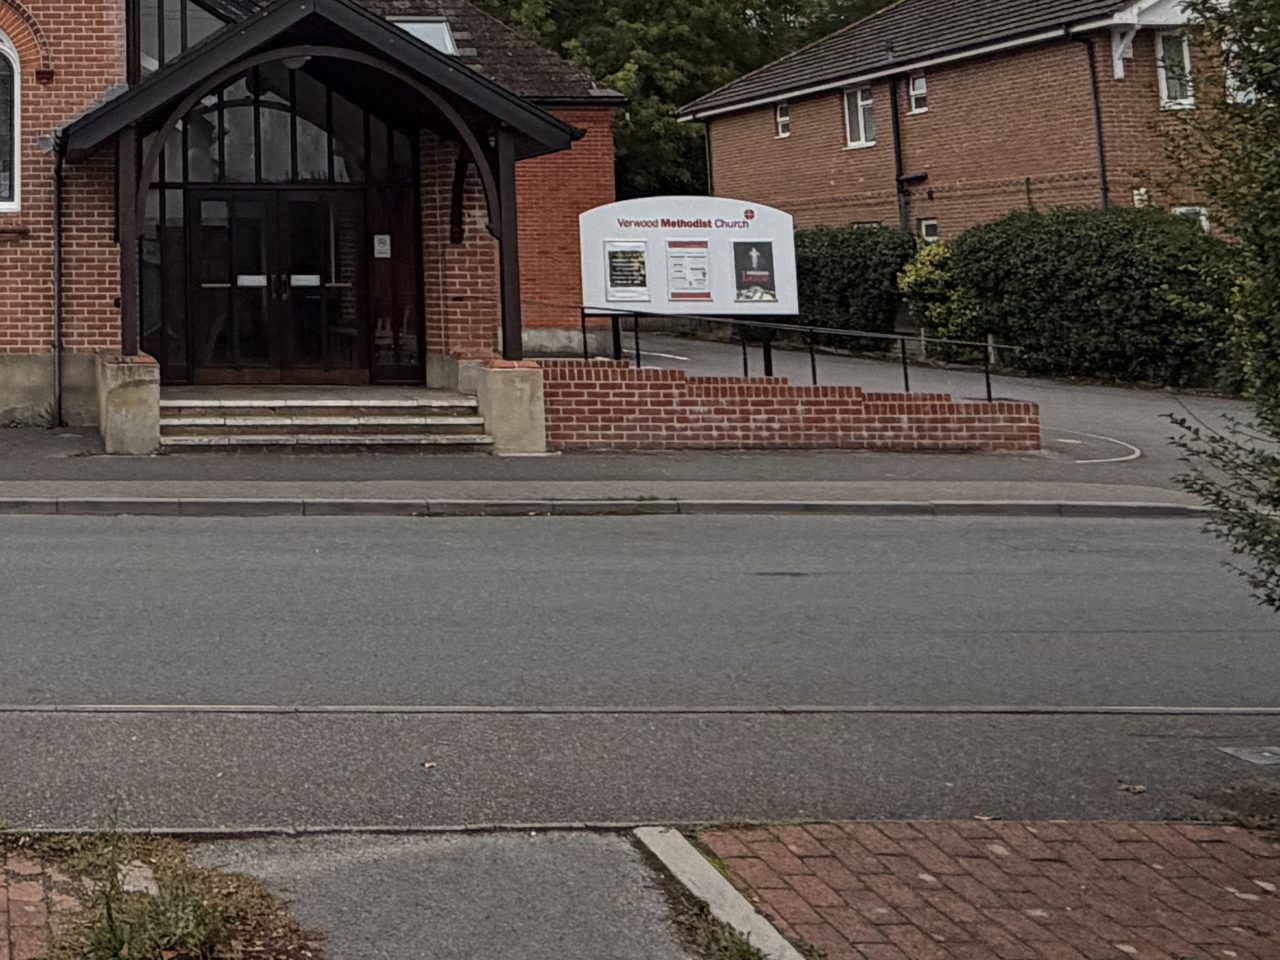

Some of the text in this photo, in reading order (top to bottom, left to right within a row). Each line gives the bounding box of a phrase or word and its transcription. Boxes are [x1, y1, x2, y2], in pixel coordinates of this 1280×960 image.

[617, 218, 750, 229] Verwood Methodist Church
